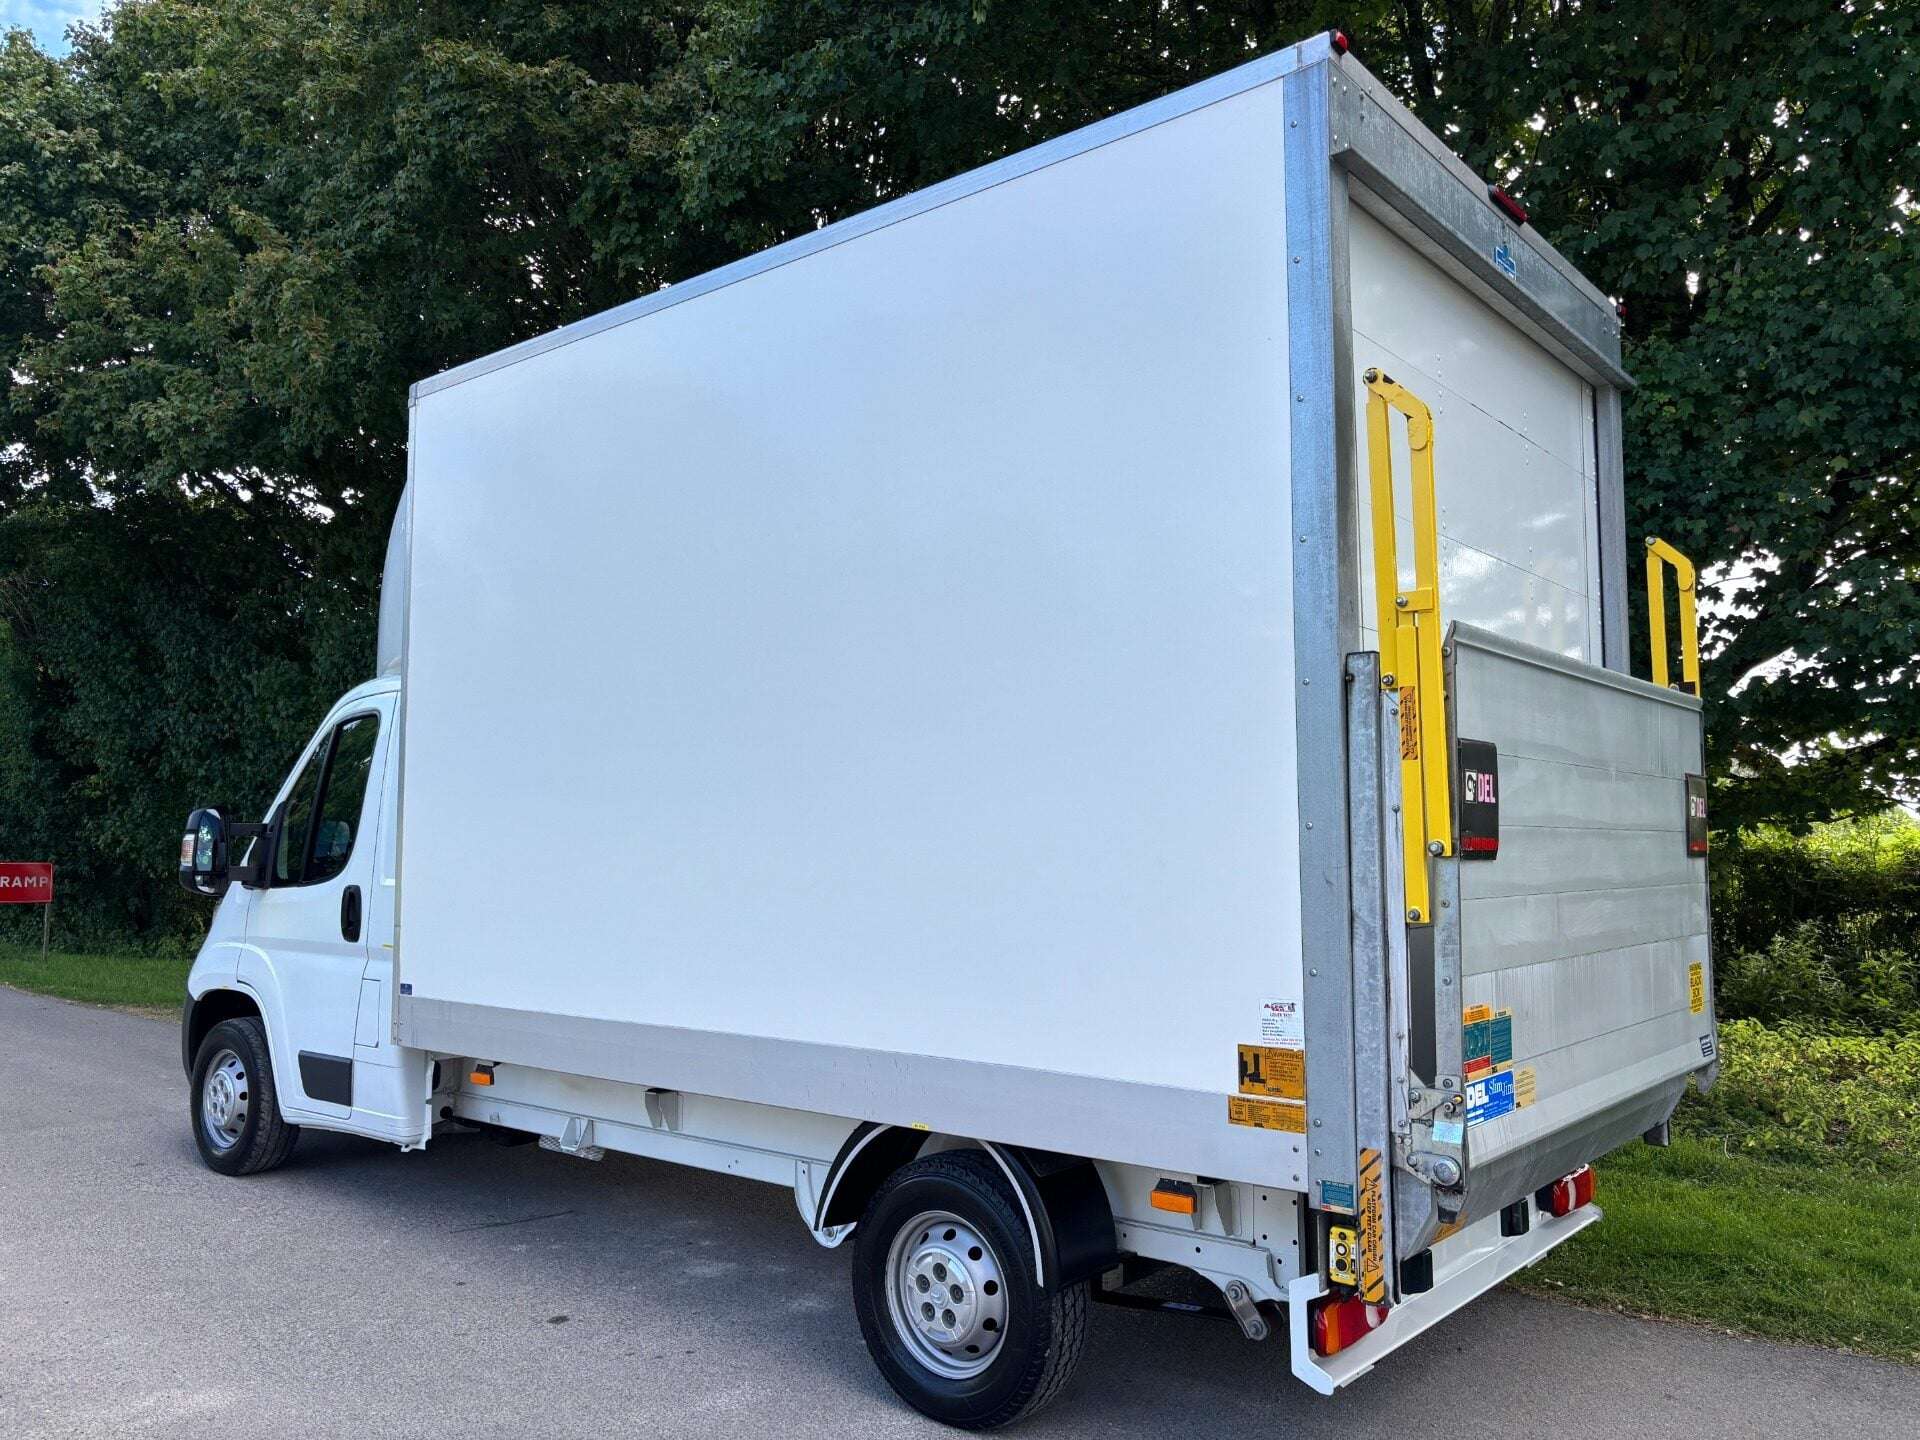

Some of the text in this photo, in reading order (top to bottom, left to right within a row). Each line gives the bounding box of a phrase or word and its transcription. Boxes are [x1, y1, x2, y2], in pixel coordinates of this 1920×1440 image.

[1478, 773, 1496, 804] DEL
[1696, 797, 1706, 818] DEL
[0, 876, 49, 888] RAMP
[1466, 1082, 1490, 1110] DEL
